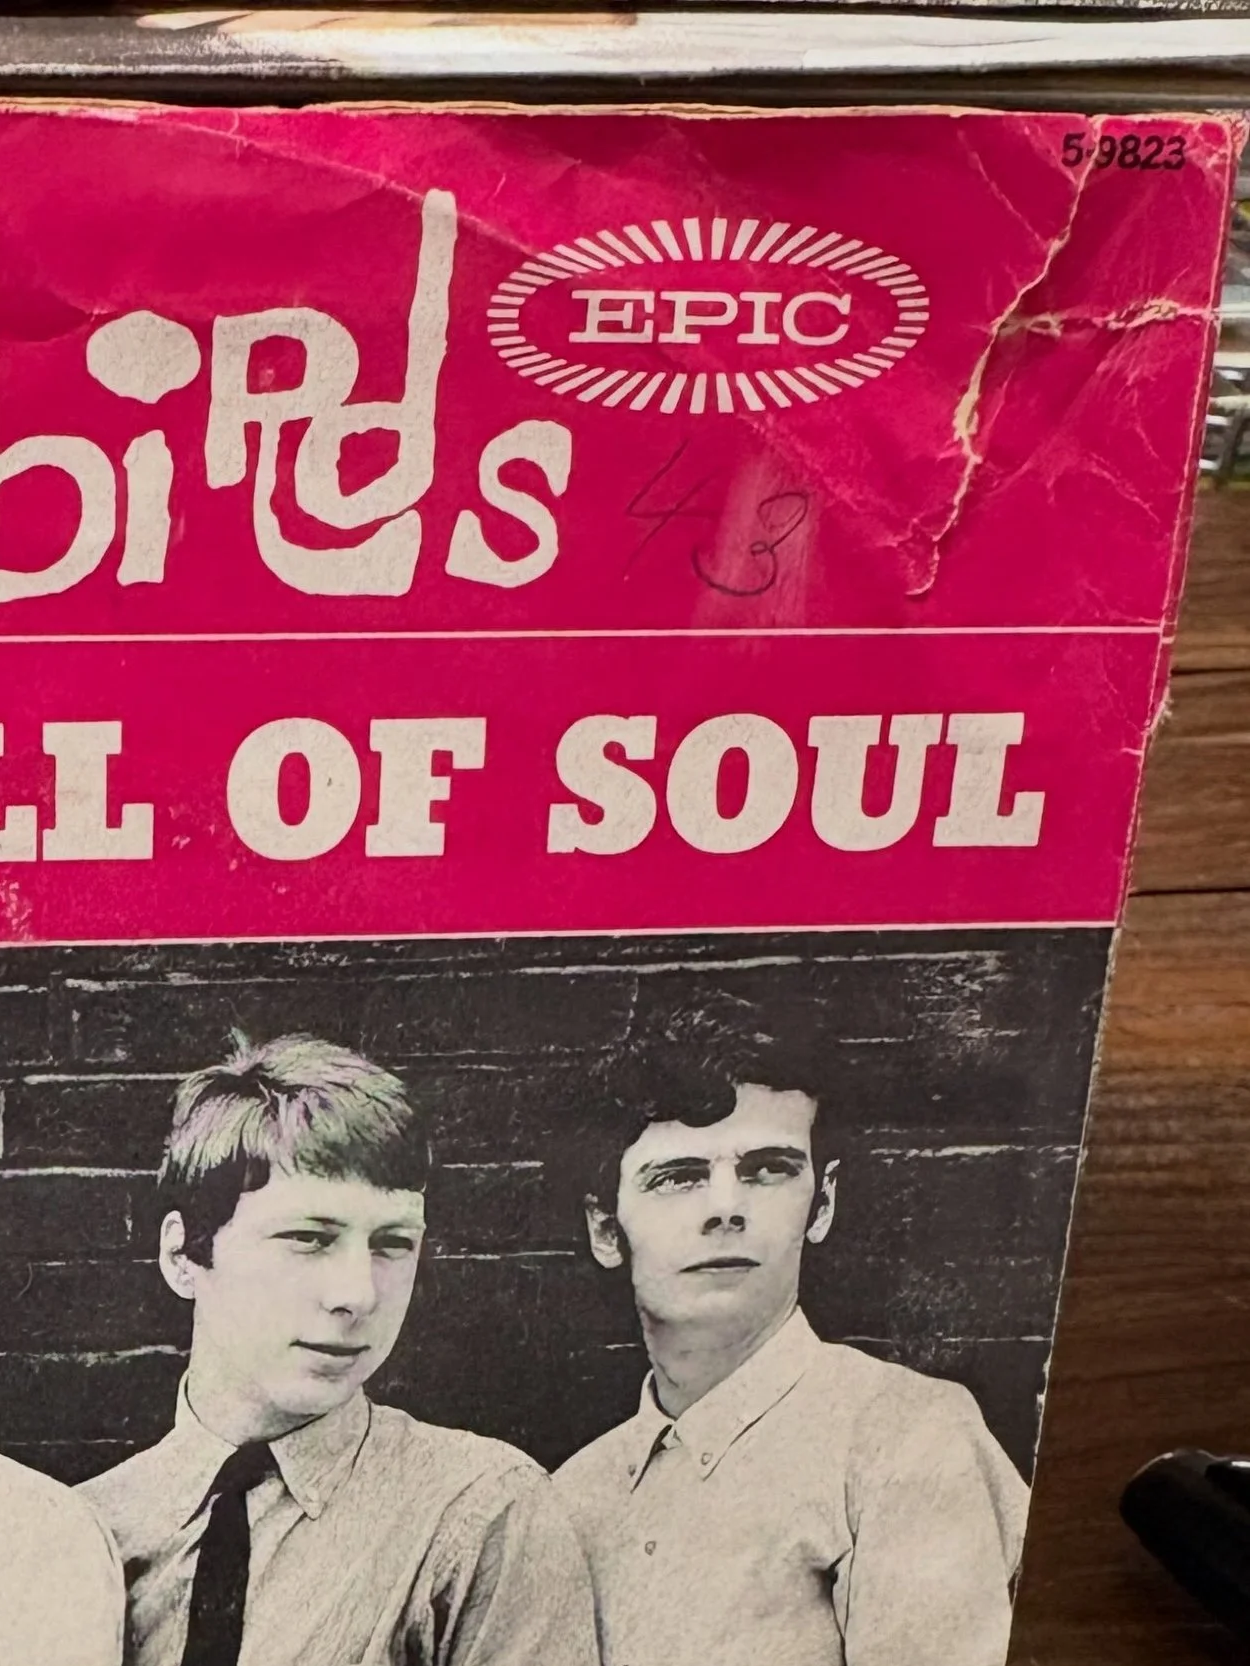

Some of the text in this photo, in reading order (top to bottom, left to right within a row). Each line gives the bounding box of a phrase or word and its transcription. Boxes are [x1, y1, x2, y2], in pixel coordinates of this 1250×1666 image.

[1061, 132, 1187, 170] 5-9823
[568, 289, 852, 348] EPIC
[226, 716, 487, 862] OF
[546, 711, 1047, 855] SOUL
